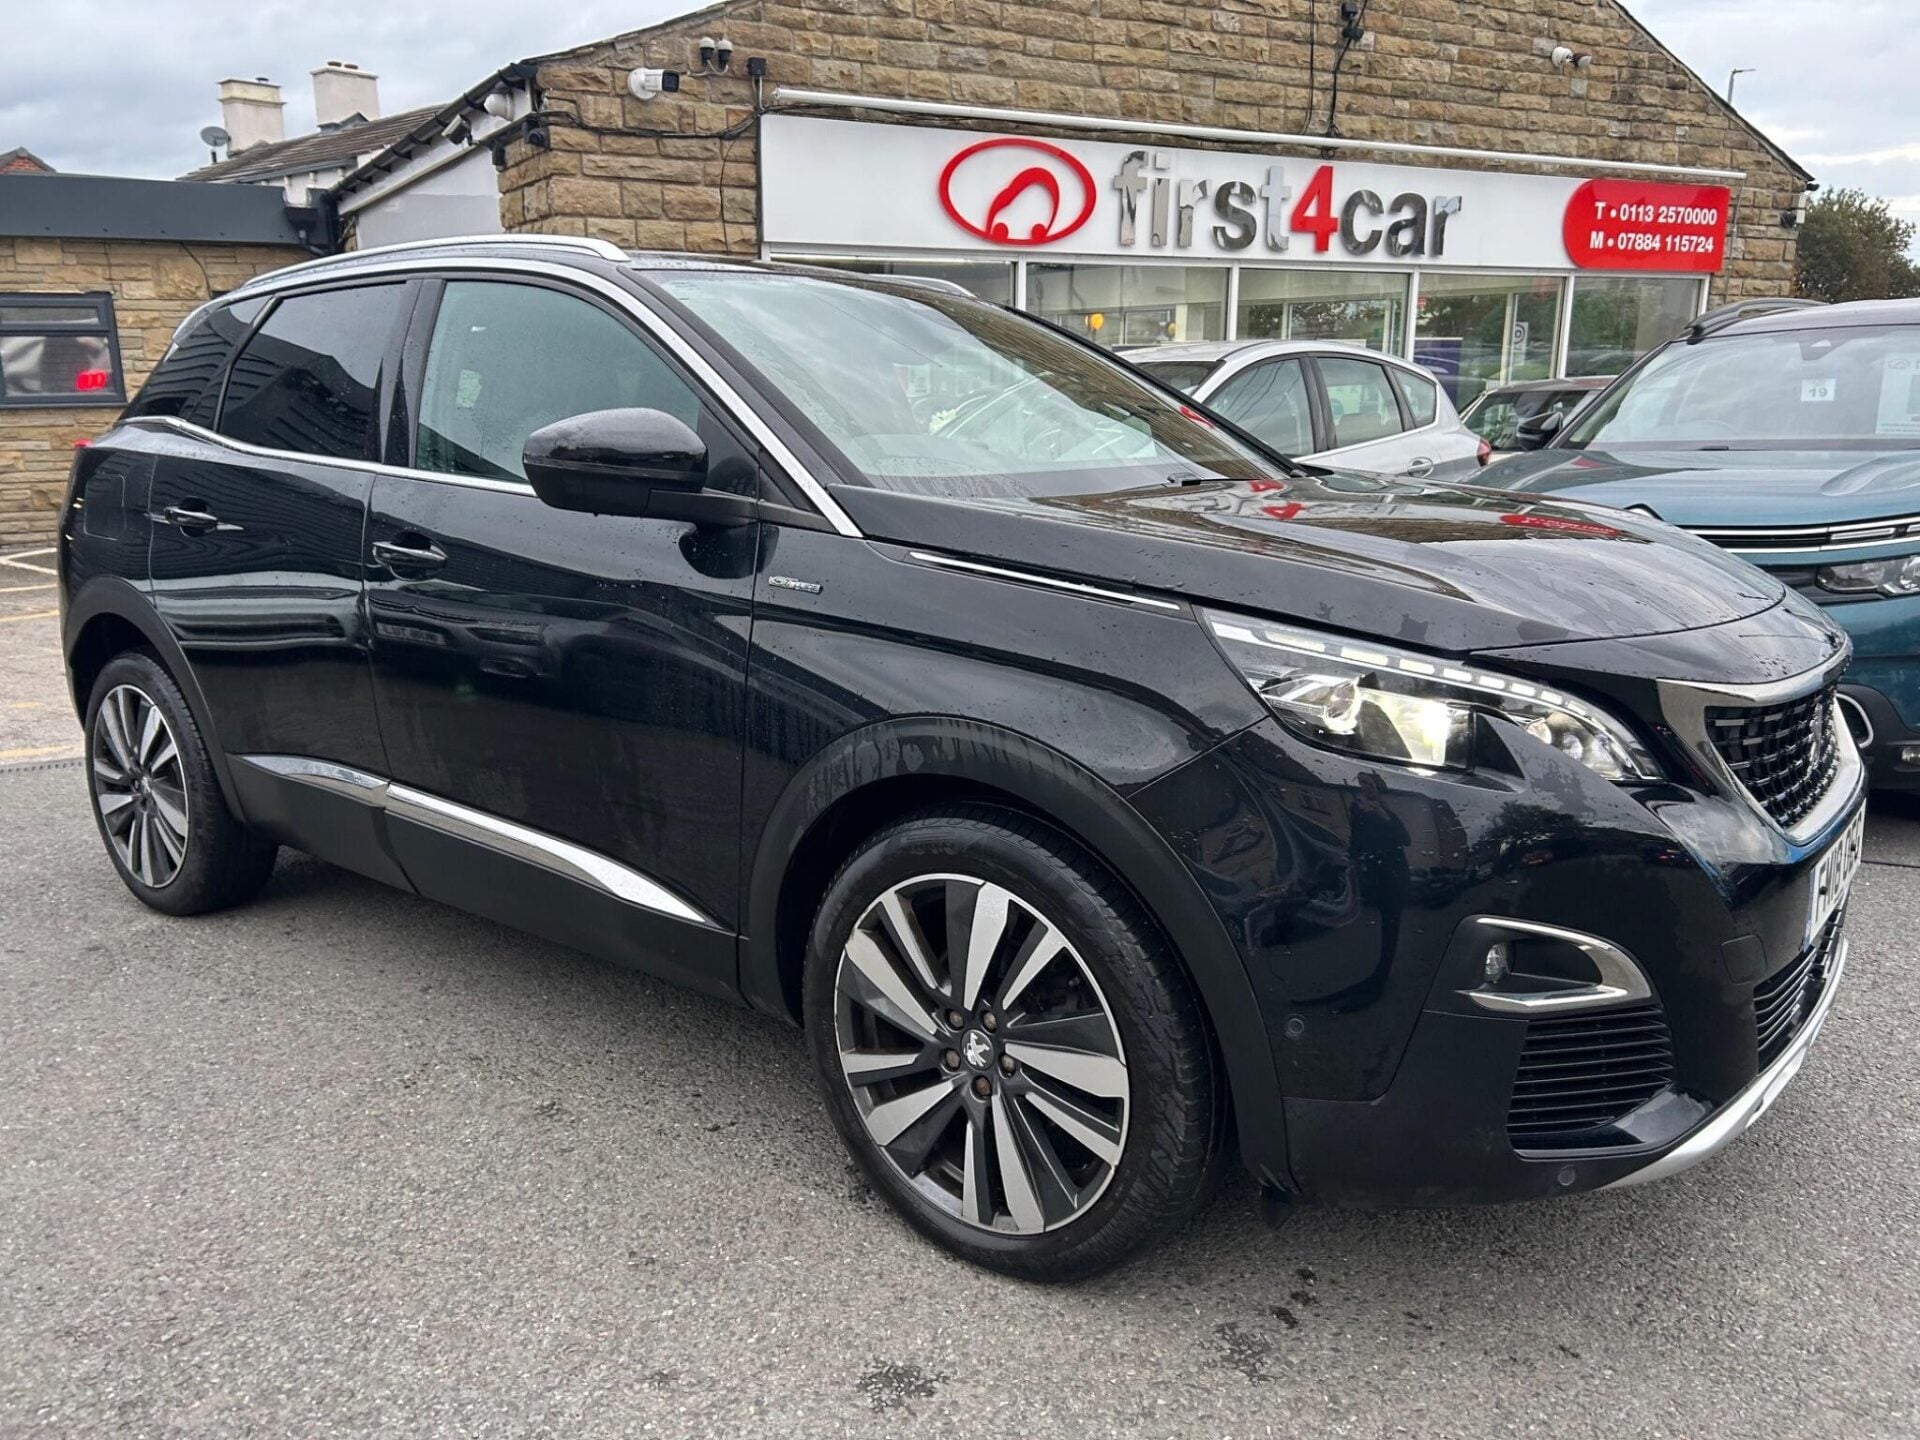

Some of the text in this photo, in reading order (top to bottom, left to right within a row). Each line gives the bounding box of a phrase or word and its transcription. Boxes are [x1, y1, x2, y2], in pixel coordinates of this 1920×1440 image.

[1114, 150, 1462, 256] first4car
[1595, 202, 1717, 225] T 0113 2570000
[1590, 231, 1713, 252] M 07884 115724
[1809, 387, 1828, 398] 19
